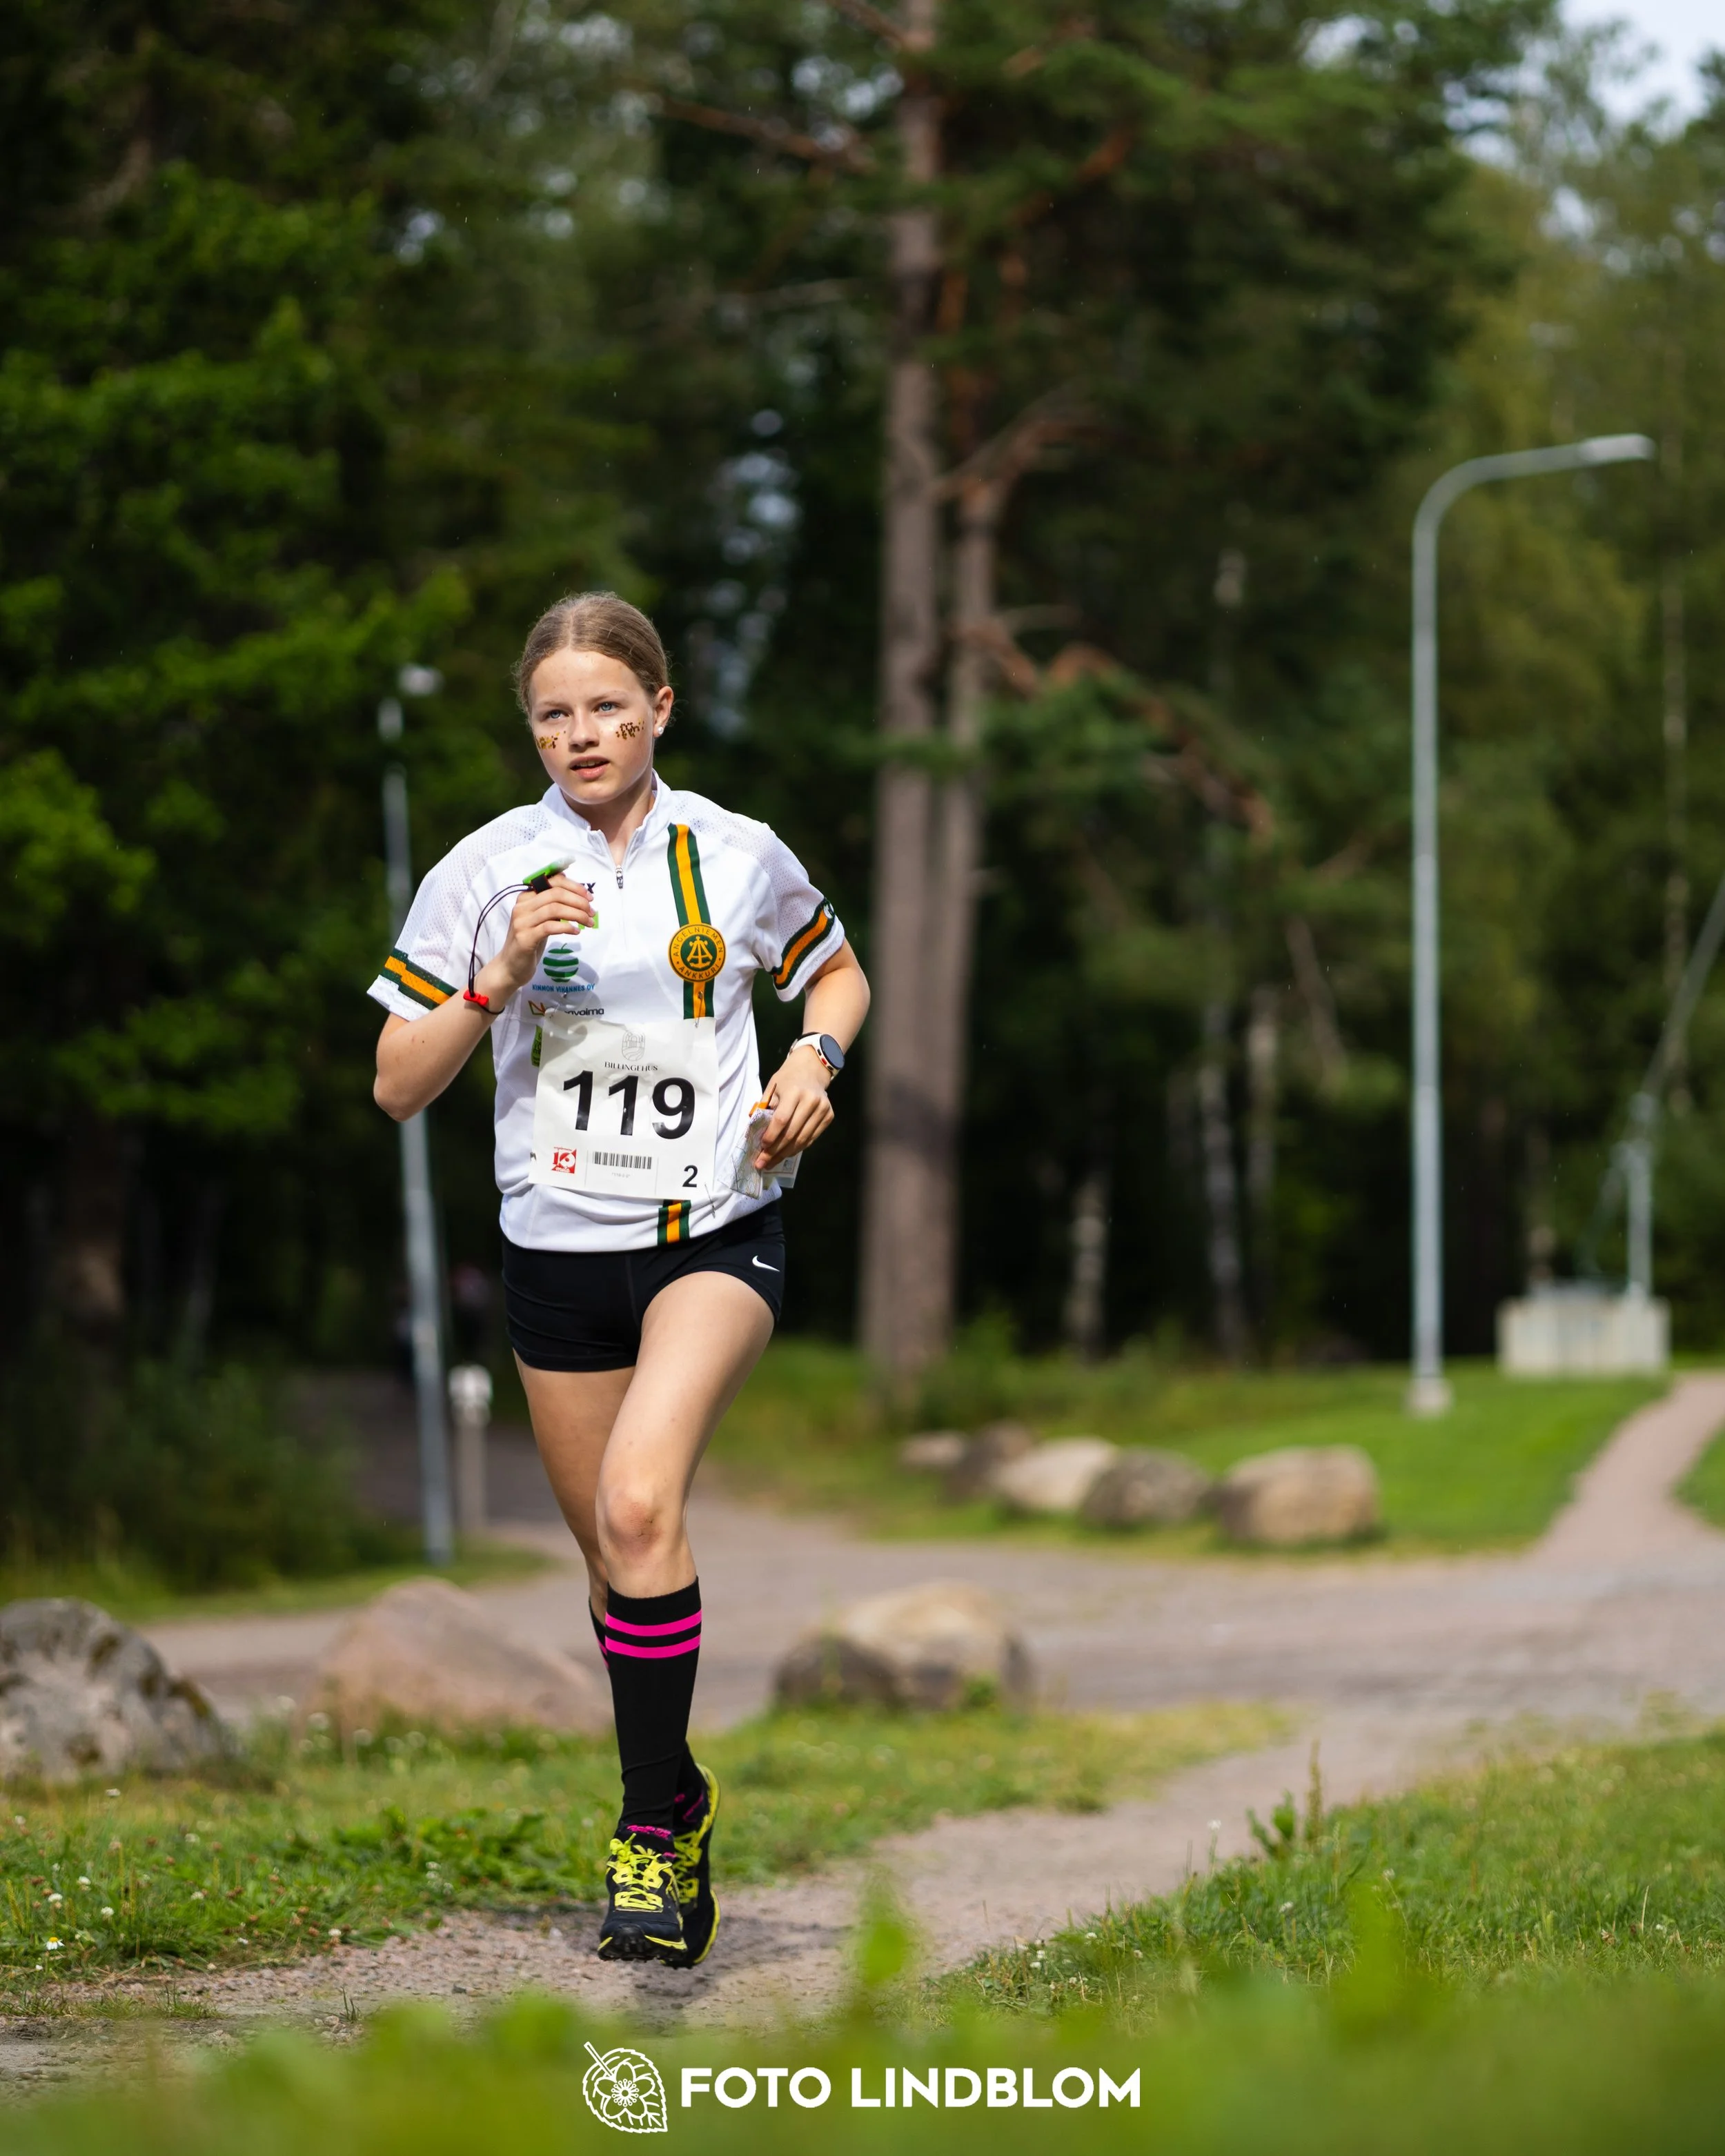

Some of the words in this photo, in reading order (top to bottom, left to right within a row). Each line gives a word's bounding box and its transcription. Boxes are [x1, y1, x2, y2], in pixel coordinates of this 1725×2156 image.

[673, 927, 724, 956] ANGELNIEMEN
[678, 963, 720, 979] ANKKURI
[604, 1061, 658, 1071] BILLINGEHUS
[563, 1070, 695, 1140] 119
[682, 1165, 698, 1187] 2
